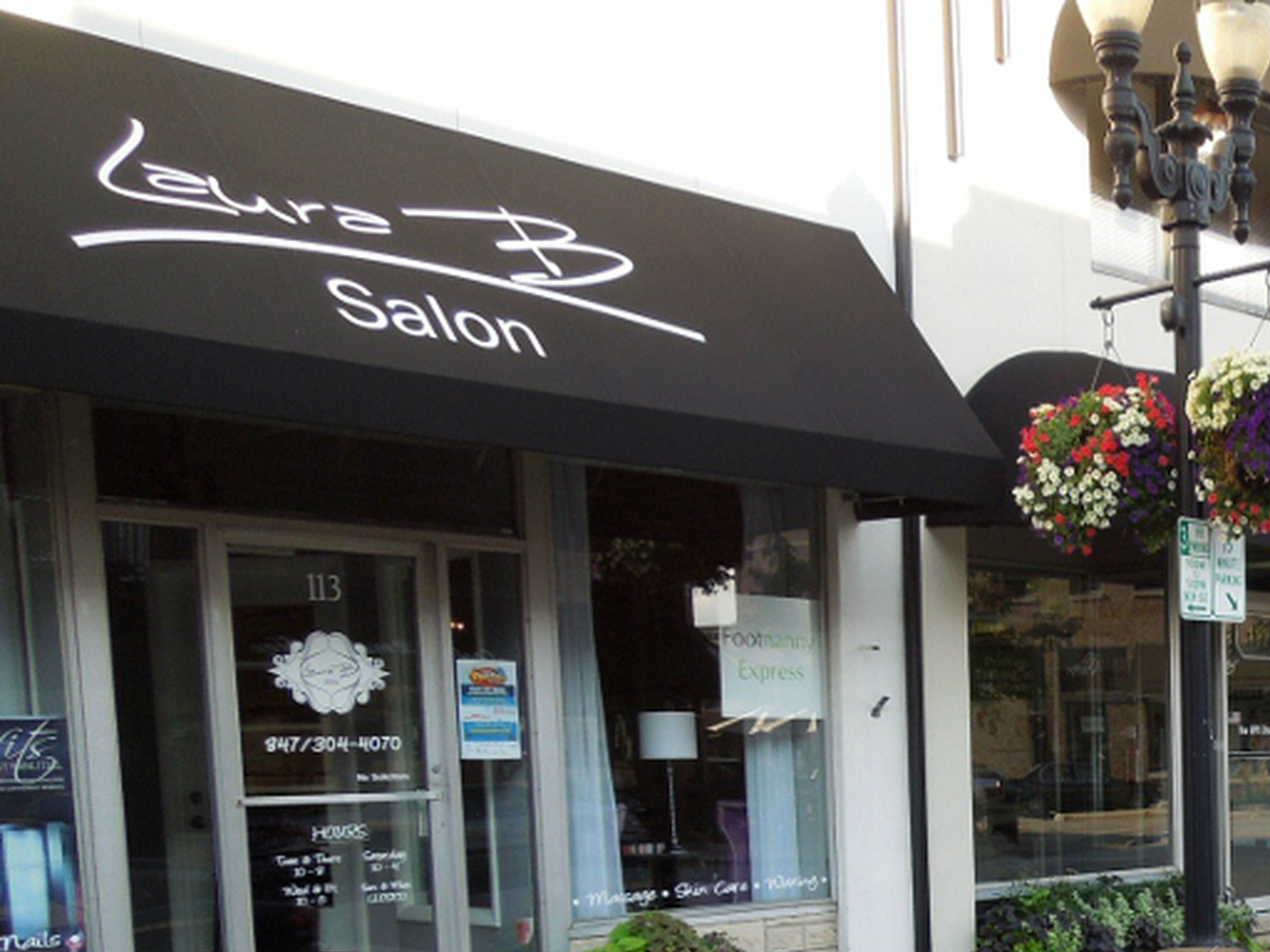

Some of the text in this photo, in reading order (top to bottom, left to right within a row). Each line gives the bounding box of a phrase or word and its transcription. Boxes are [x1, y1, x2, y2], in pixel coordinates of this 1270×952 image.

[97, 116, 634, 288] Laura B
[326, 277, 547, 358] Salon
[306, 573, 342, 601] 113
[738, 659, 804, 684] Express
[264, 735, 402, 753] 847/304-4070
